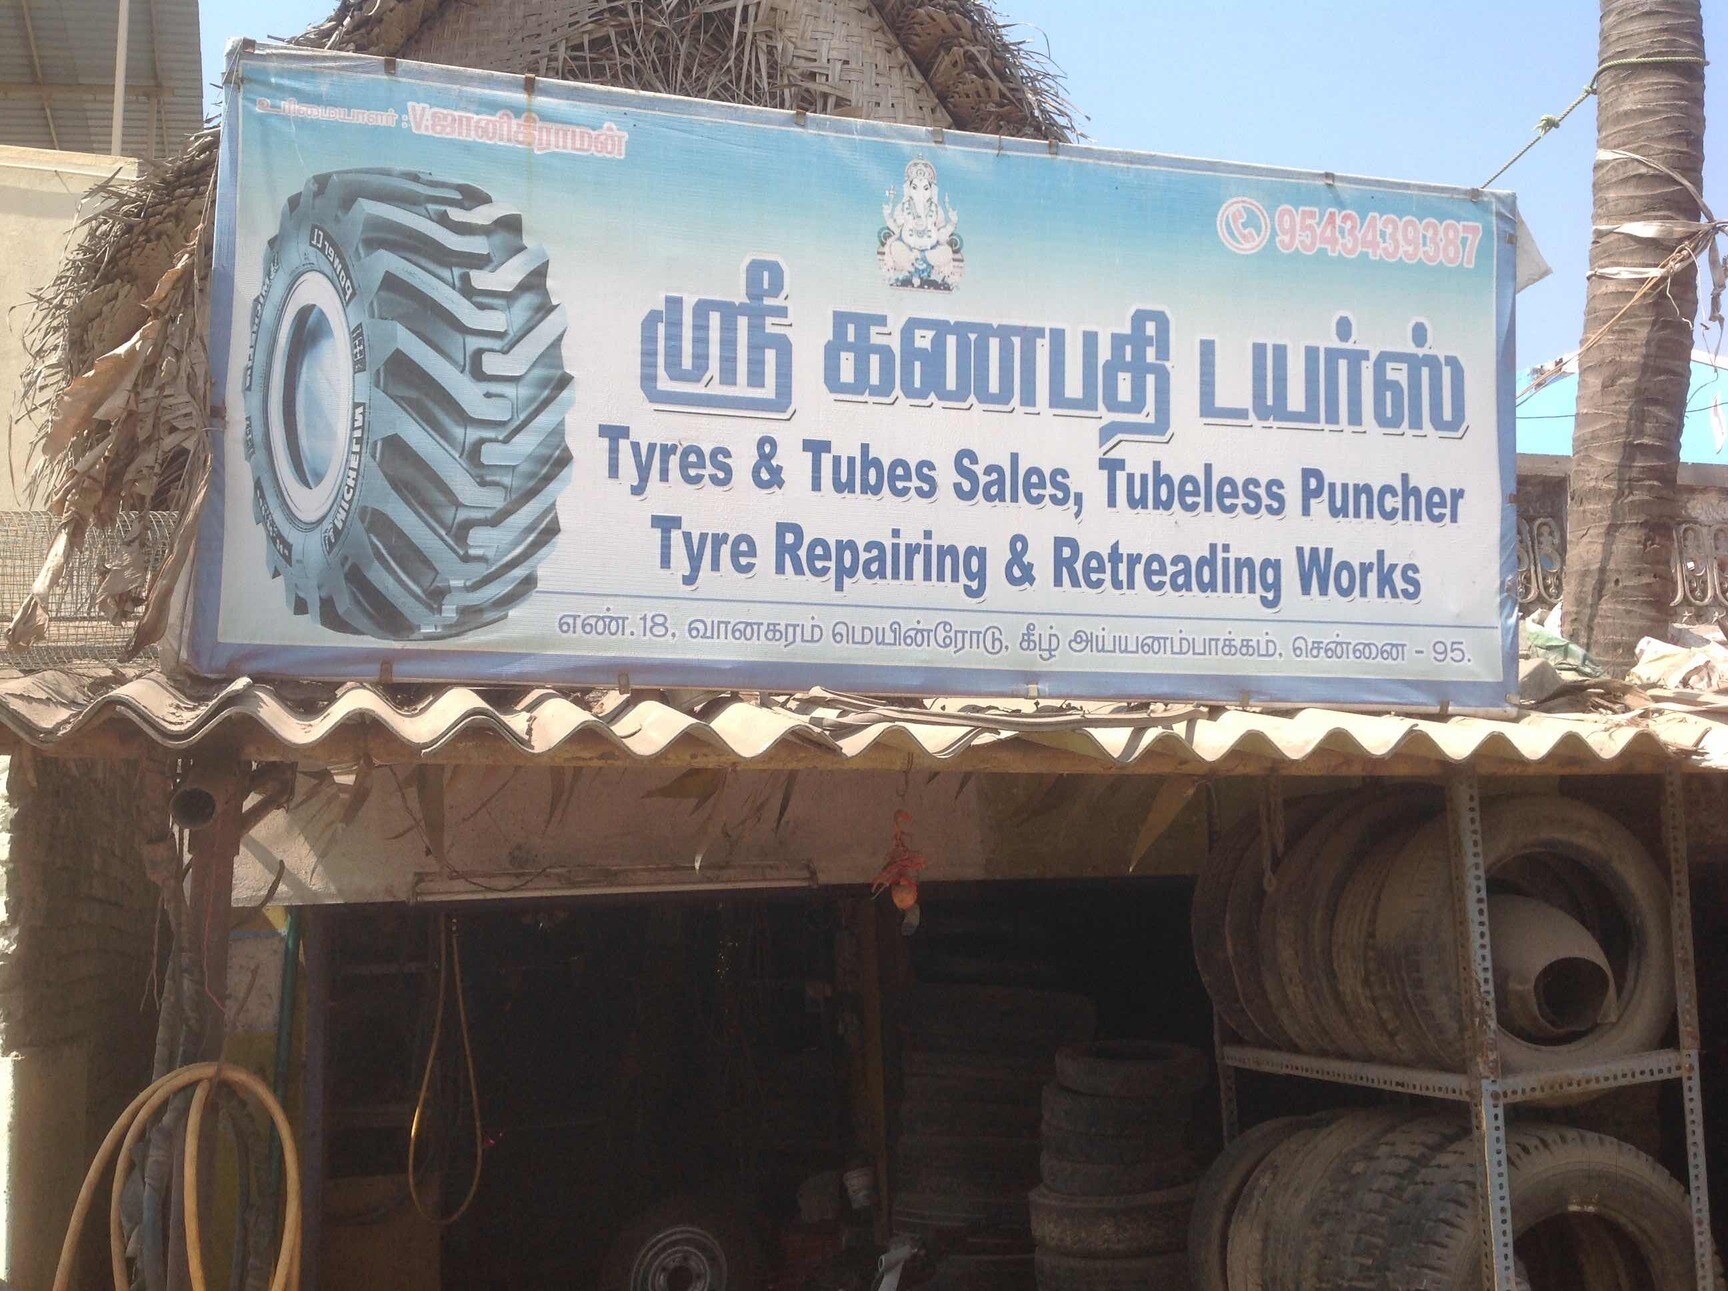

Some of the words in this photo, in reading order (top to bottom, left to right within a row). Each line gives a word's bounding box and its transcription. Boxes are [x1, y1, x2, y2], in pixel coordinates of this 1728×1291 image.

[1275, 205, 1483, 268] 9543439387
[823, 307, 1172, 450] கணபதி
[1199, 314, 1467, 436] டயர்ஸ்
[598, 423, 734, 498] Tyres
[750, 435, 786, 492] &
[802, 438, 938, 501] Tubes
[952, 447, 1084, 522] Sales,
[1099, 457, 1287, 518] Tubeless
[1300, 466, 1466, 525] Puncher
[650, 513, 758, 588] Tyre
[774, 521, 988, 601] Repairing
[1004, 533, 1037, 589] &
[1052, 535, 1283, 610] Retreading
[1295, 545, 1423, 602] Works
[687, 615, 824, 649] வானகரம்
[1019, 622, 1061, 662] கீழ்
[1292, 632, 1408, 661] சென்னை
